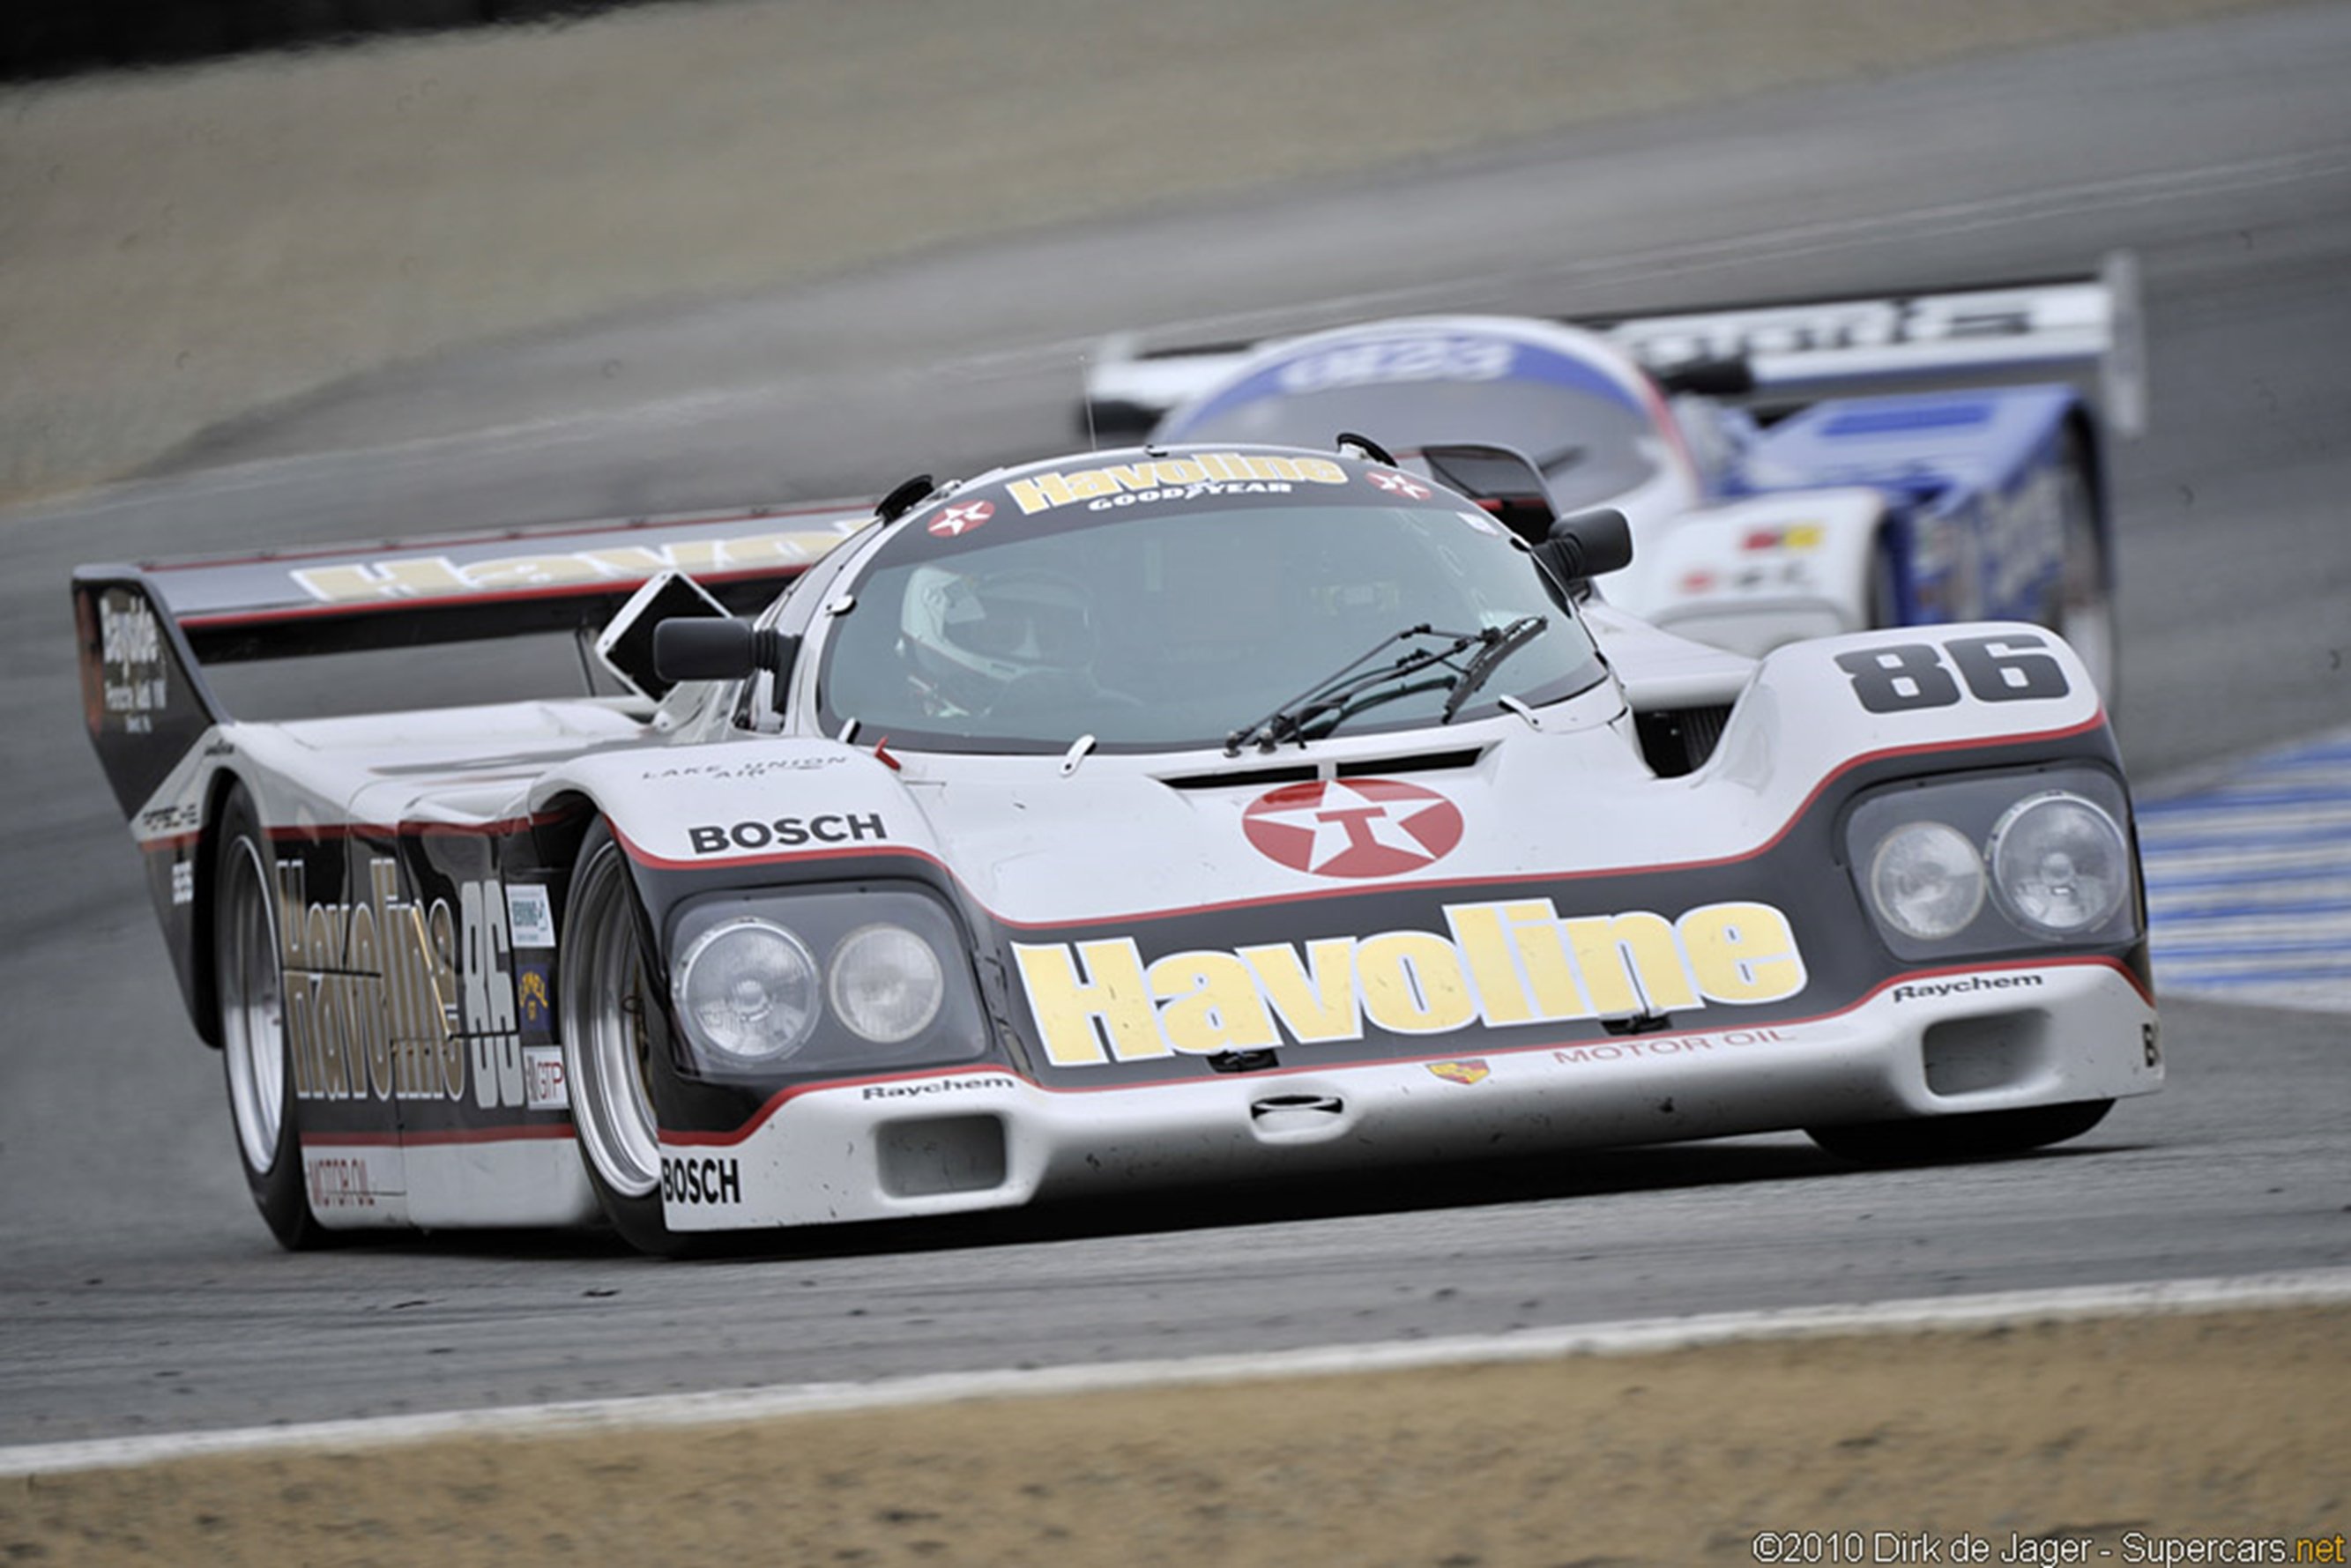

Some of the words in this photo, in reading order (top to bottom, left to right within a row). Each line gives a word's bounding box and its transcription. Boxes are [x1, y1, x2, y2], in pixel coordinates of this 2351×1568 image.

[1005, 453, 1349, 515] Havoline
[1089, 481, 1291, 511] GOODYEAR
[1833, 635, 2070, 713] 86
[642, 765, 720, 779] LAKE
[745, 756, 848, 769] UNION
[688, 813, 887, 854] BOSCH
[276, 858, 465, 1102] Havoline
[460, 880, 525, 1110] 86
[1011, 898, 1808, 1066] Havoline
[1893, 974, 2043, 1003] Raychem
[1551, 1036, 1712, 1065] MOTOR
[1722, 1029, 1797, 1046] OIL
[538, 1060, 566, 1100] GTP
[861, 1074, 1015, 1101] Raychem
[661, 1157, 741, 1205] BOSCH
